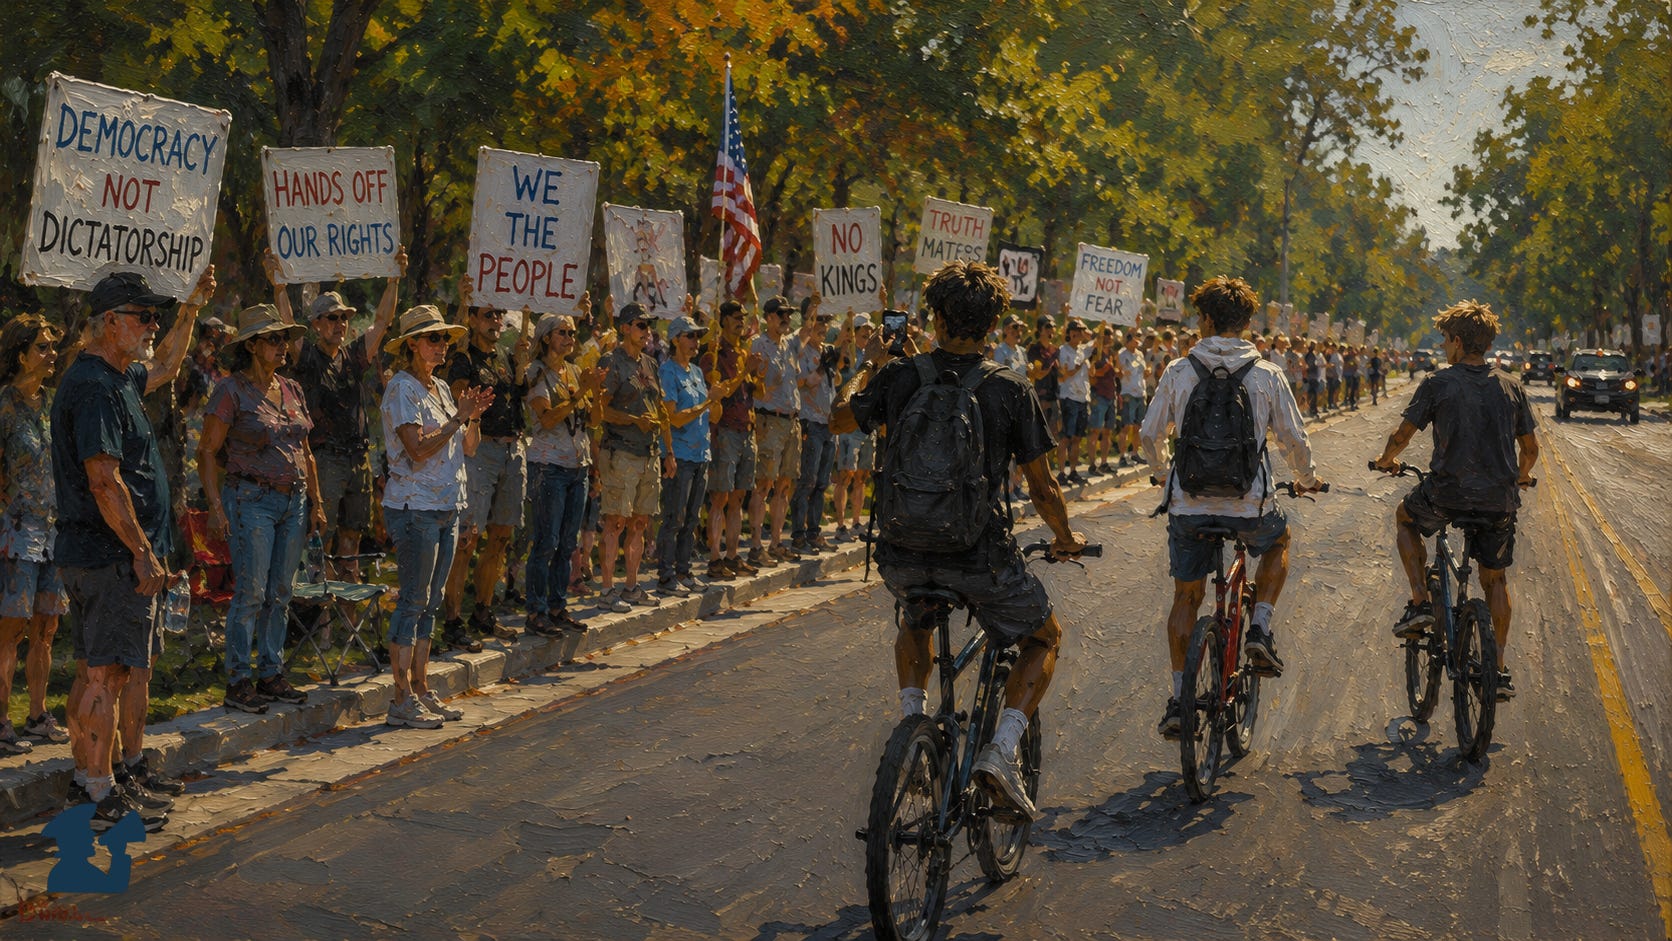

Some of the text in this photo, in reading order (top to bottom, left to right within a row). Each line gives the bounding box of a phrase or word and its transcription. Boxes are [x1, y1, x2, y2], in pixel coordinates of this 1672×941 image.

[56, 102, 218, 175] DEMOCRACY
[102, 173, 161, 213] NOT
[273, 169, 388, 208] HANDS OFF
[512, 165, 562, 205] WE
[39, 210, 204, 273] DICTATORSHIP
[277, 222, 394, 260] OUR RIGHTS
[505, 211, 559, 250] THE
[831, 222, 863, 254] NO
[930, 209, 985, 239] TRUTH
[477, 253, 578, 299] PEOPLE
[821, 263, 877, 297] KINGS
[1081, 253, 1143, 279] FREEDOM
[1095, 276, 1123, 295] NOT
[1085, 294, 1123, 316] FEAR
